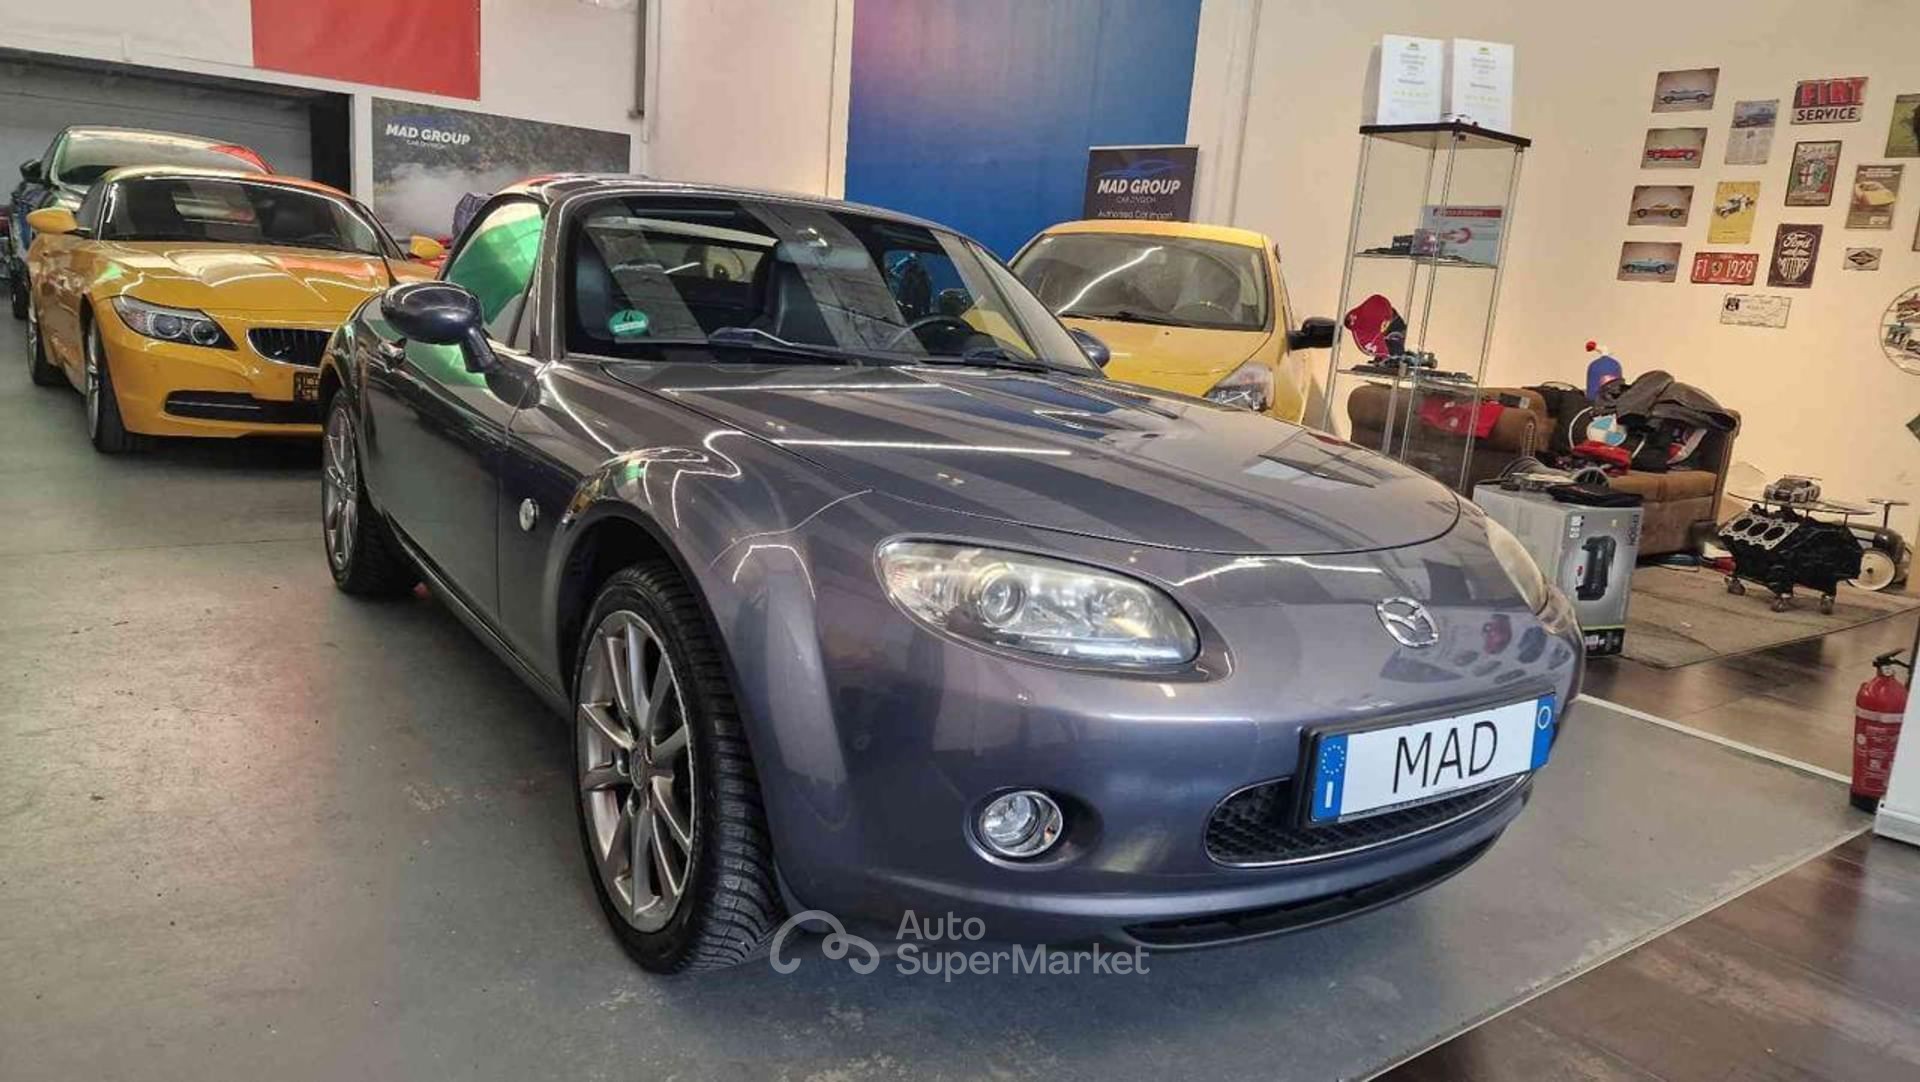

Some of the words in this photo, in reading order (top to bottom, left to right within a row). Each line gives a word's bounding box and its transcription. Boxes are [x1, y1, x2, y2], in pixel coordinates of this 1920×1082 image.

[1801, 79, 1865, 106] FIAT
[1796, 107, 1856, 121] SERVICE
[385, 124, 419, 139] MAD
[421, 129, 471, 145] GROUP
[1097, 179, 1128, 194] MAD
[1130, 179, 1181, 195] GROUP
[1783, 233, 1812, 248] Ford
[1727, 260, 1754, 279] 1929
[1392, 720, 1498, 794] MAD
